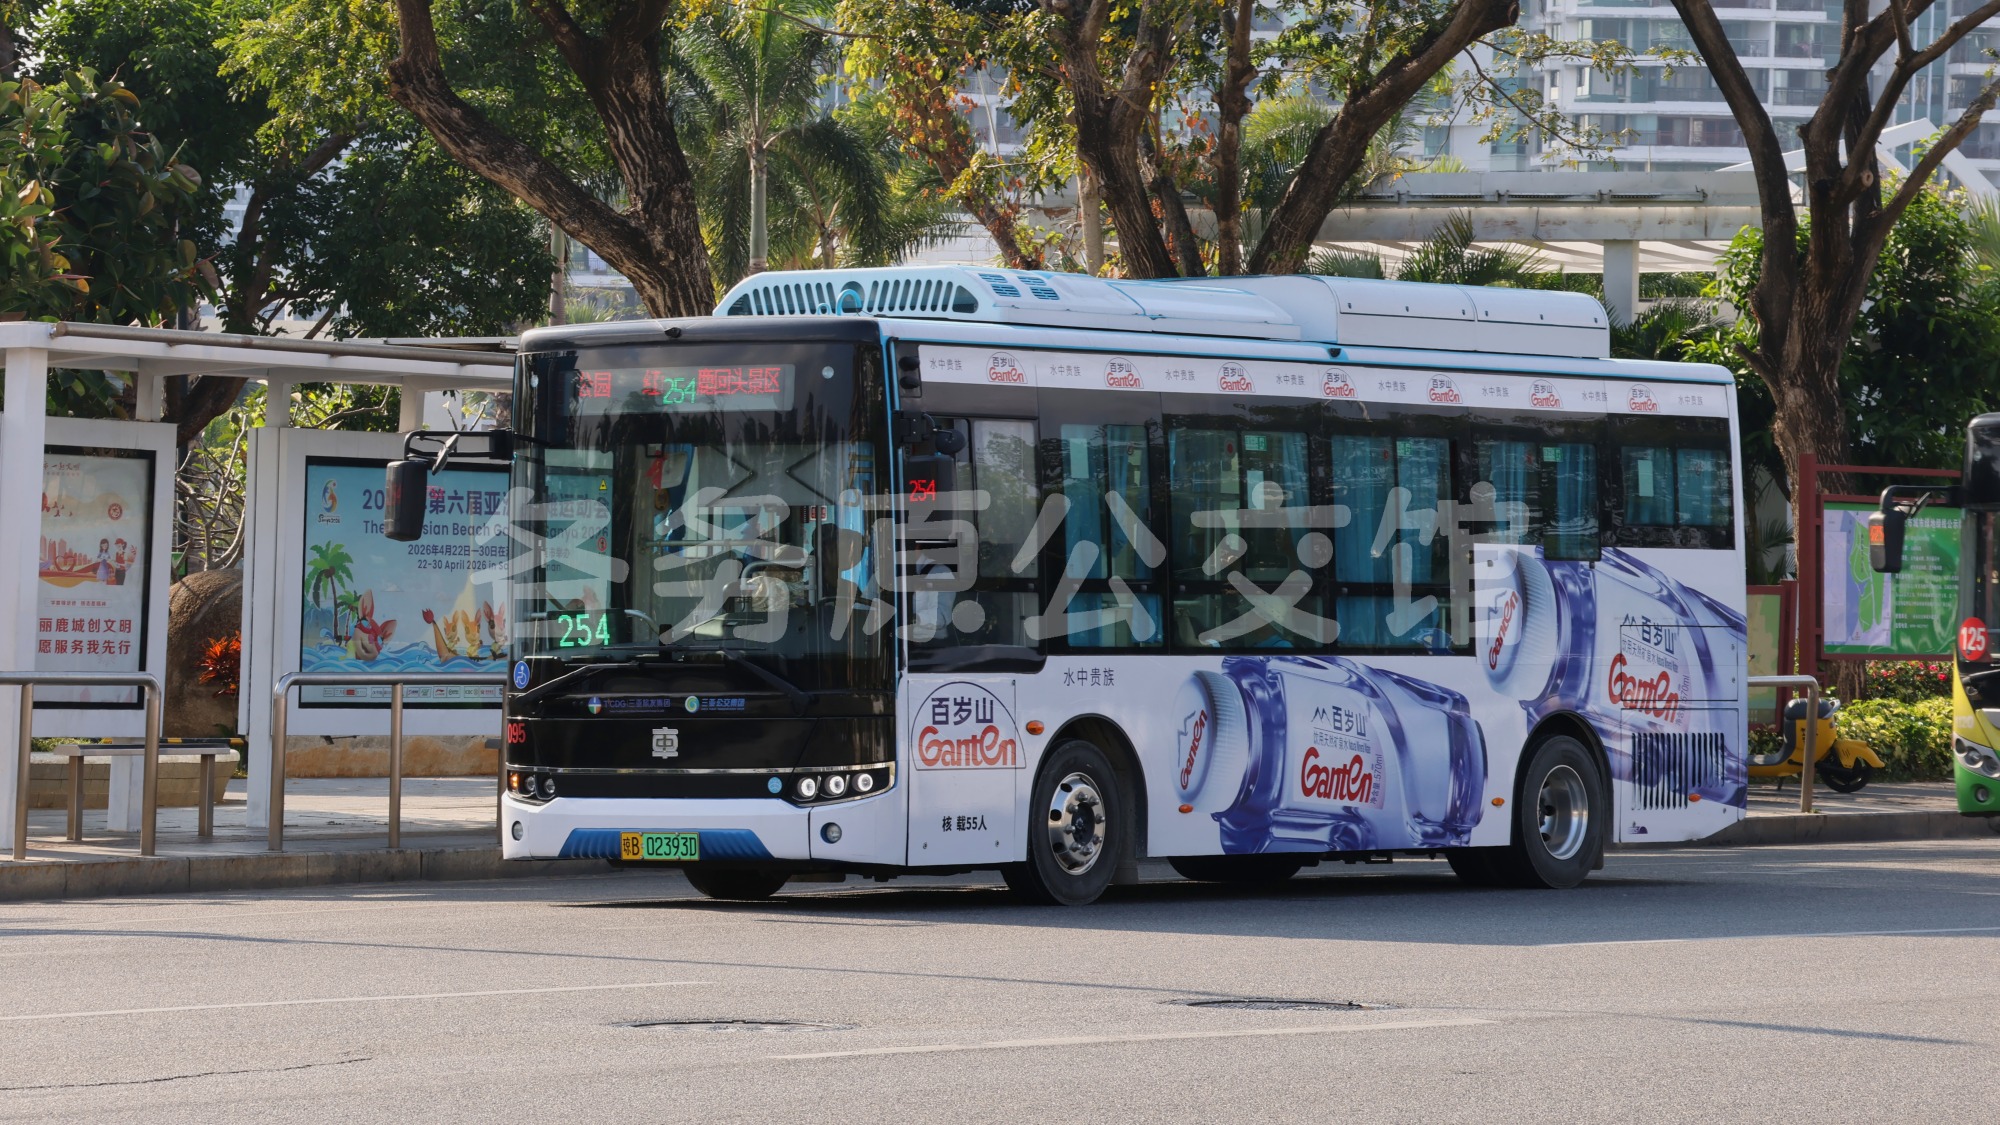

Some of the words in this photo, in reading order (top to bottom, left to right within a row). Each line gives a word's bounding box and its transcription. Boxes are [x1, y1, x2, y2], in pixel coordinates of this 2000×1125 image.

[930, 358, 963, 371] 水中贵族
[993, 356, 1015, 367] 百岁山
[1110, 362, 1133, 373] 百岁山
[989, 367, 1026, 384] Ganten
[1050, 364, 1082, 376] 水中贵族
[1165, 369, 1195, 381] 水中贵族
[1223, 366, 1244, 377] 百岁山
[1327, 372, 1347, 383] 百岁山
[1106, 372, 1142, 388] Ganten
[1220, 376, 1254, 392] Ganten
[1276, 374, 1305, 386] 水中贵族
[1432, 379, 1452, 389] 百岁山
[663, 377, 696, 404] 254
[1534, 384, 1553, 394] 百岁山
[909, 479, 936, 502] 254
[363, 520, 385, 534] The
[422, 522, 449, 536] sian
[452, 522, 490, 537] Beach
[417, 560, 443, 570] 22-30
[445, 560, 465, 575] April
[467, 560, 487, 570] 2026
[39, 618, 132, 634] 丽鹿城创文明
[558, 613, 610, 647] 254
[1641, 615, 1676, 655] 百岁山
[1961, 627, 1986, 651] 125
[38, 640, 131, 655] 愿服务我先行
[1063, 667, 1115, 687] 水中贵族
[1608, 653, 1679, 723] Ganten
[931, 696, 994, 726] 百岁山
[1332, 705, 1367, 738] 百岁山
[918, 725, 1017, 767] Ganten
[1180, 709, 1208, 791] Ganten
[1301, 747, 1372, 804] Ganten
[646, 837, 697, 857] 02393D
